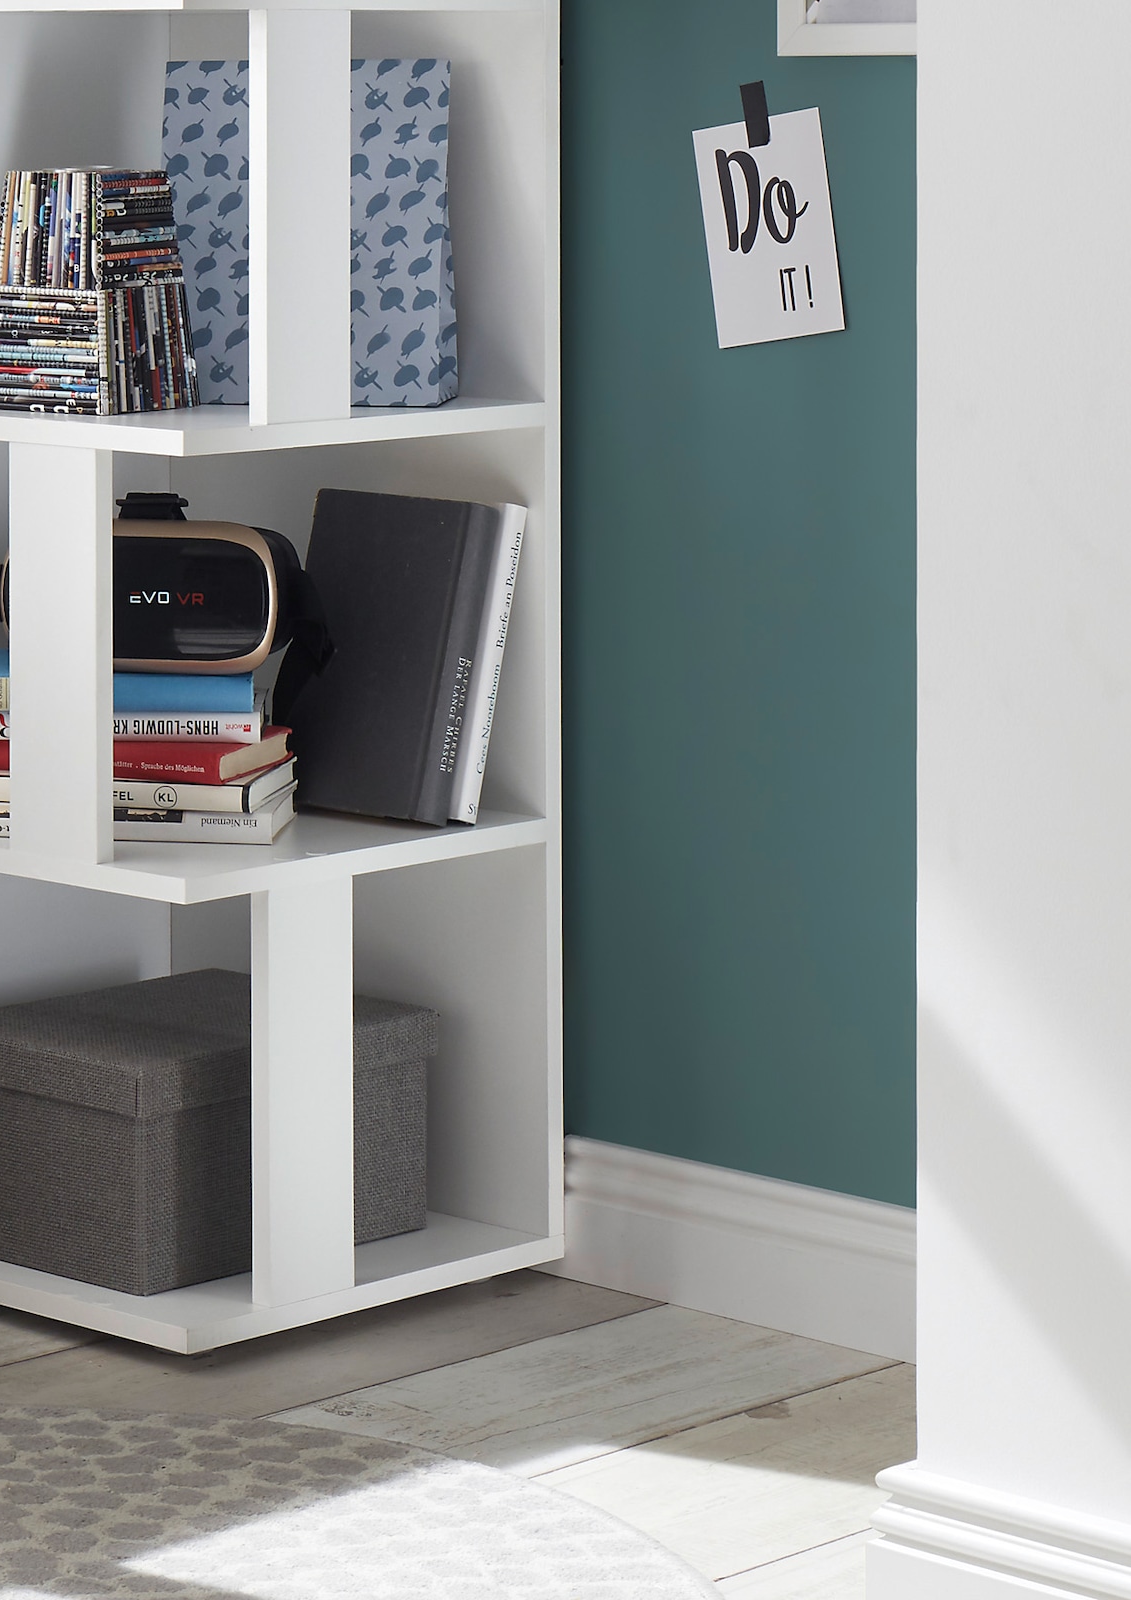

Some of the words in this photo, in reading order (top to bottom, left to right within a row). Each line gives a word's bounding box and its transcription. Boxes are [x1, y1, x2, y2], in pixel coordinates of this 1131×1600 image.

[715, 148, 809, 254] Do
[505, 531, 522, 587] Poseidon
[129, 590, 170, 605] EVO
[176, 592, 205, 606] VR
[505, 592, 513, 608] an
[495, 611, 508, 649] Briefe
[455, 656, 467, 680] DER
[448, 684, 461, 720] LANGE
[481, 664, 501, 739] Nooteboom
[133, 719, 219, 736] HANS-LUDWIG
[439, 725, 455, 772] MARSCH
[476, 743, 487, 774] Cees
[140, 761, 164, 771] Sprache
[175, 764, 205, 773] Möglichen
[158, 793, 174, 802] KL
[201, 818, 240, 828] Niemand
[243, 819, 257, 828] Ein
